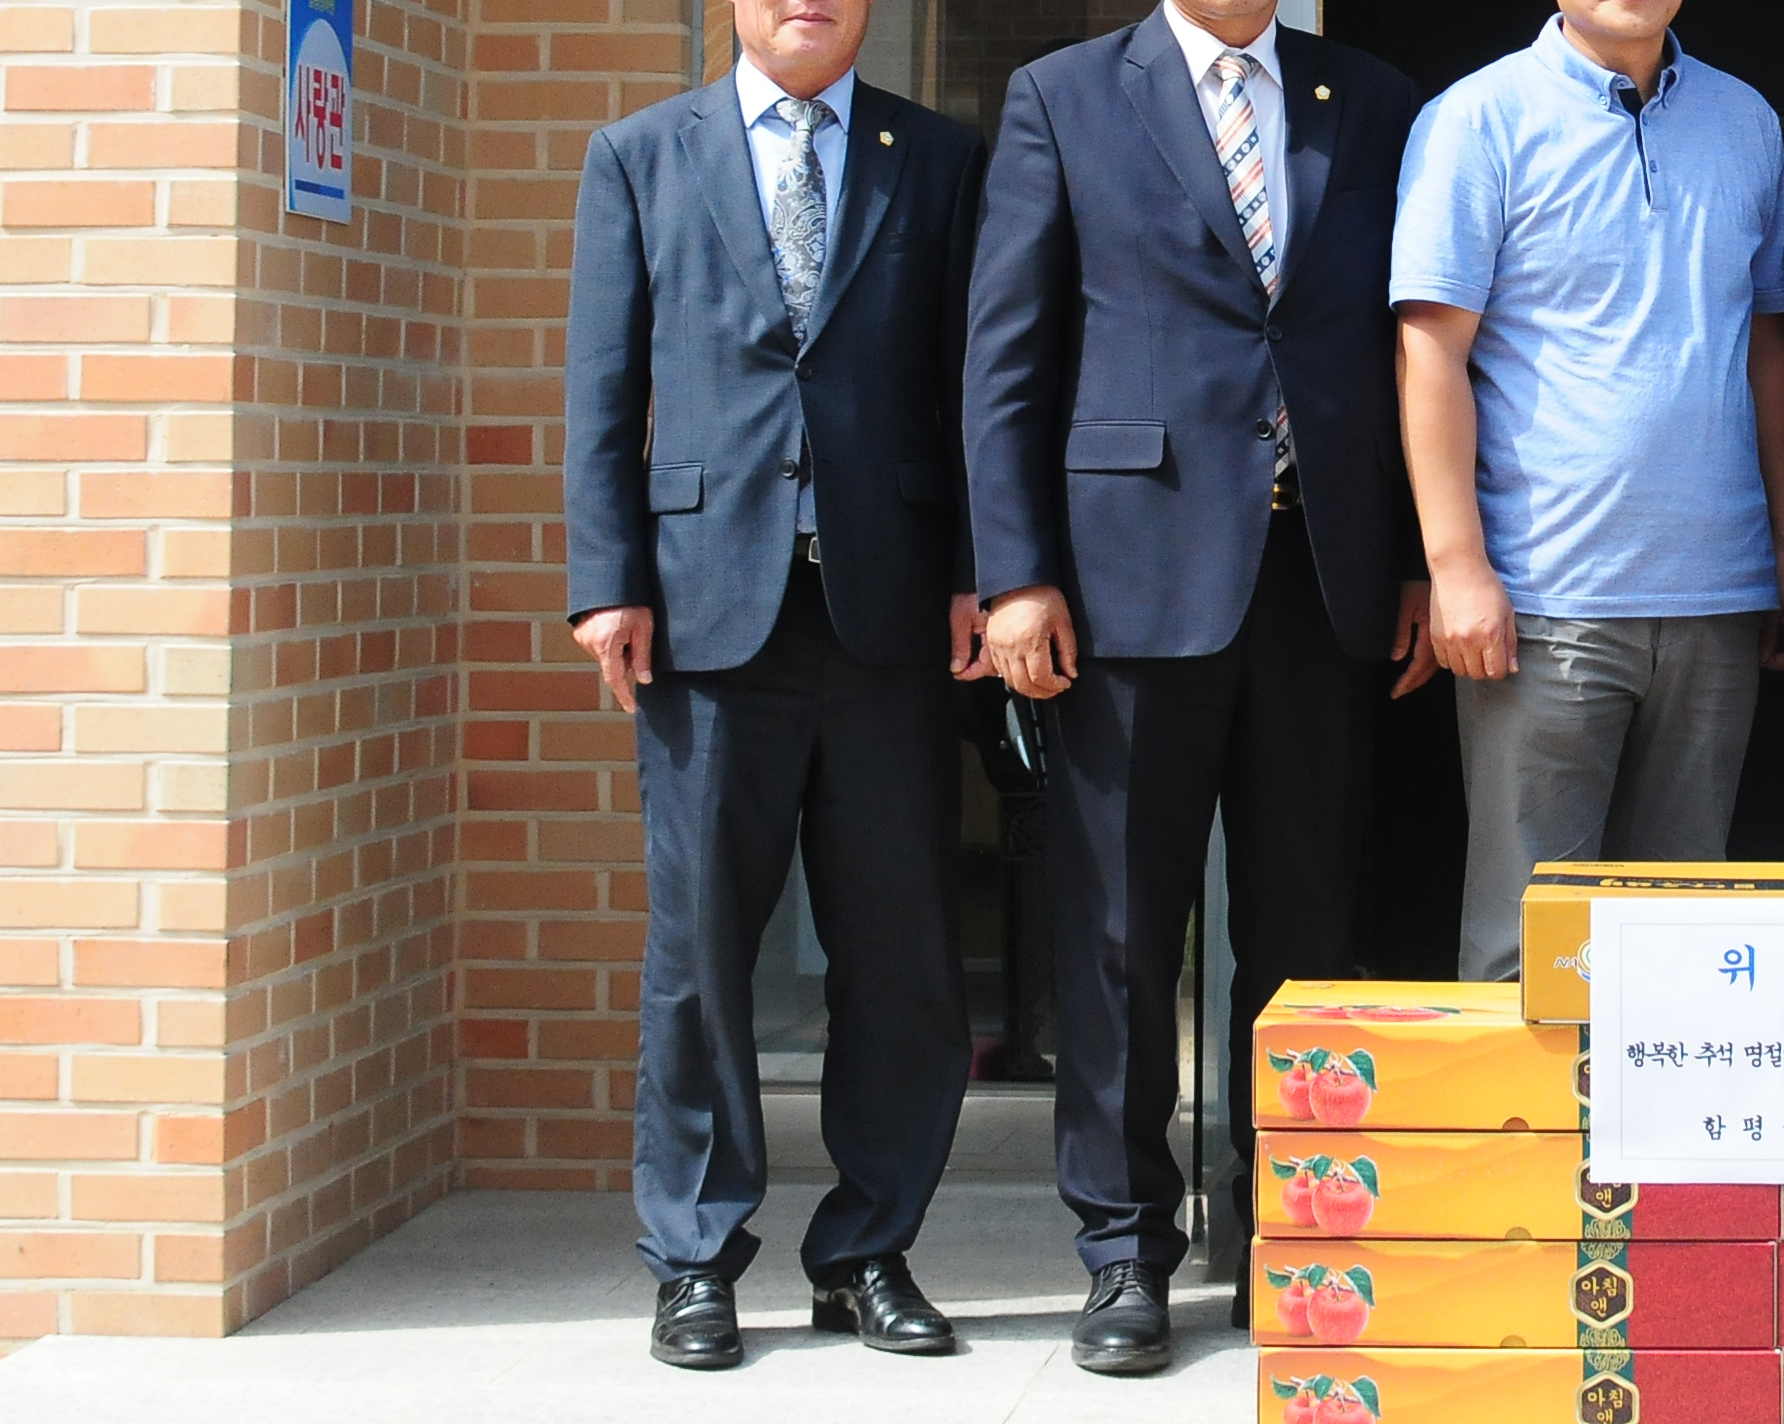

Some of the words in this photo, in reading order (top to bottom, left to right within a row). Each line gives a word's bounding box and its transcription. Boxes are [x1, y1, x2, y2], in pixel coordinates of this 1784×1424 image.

[294, 64, 346, 170] 사랑관
[1625, 1041, 1689, 1068] 행복한
[1694, 1041, 1734, 1068] 추석
[1581, 1276, 1618, 1298] 아침
[1587, 1386, 1625, 1409] 아침
